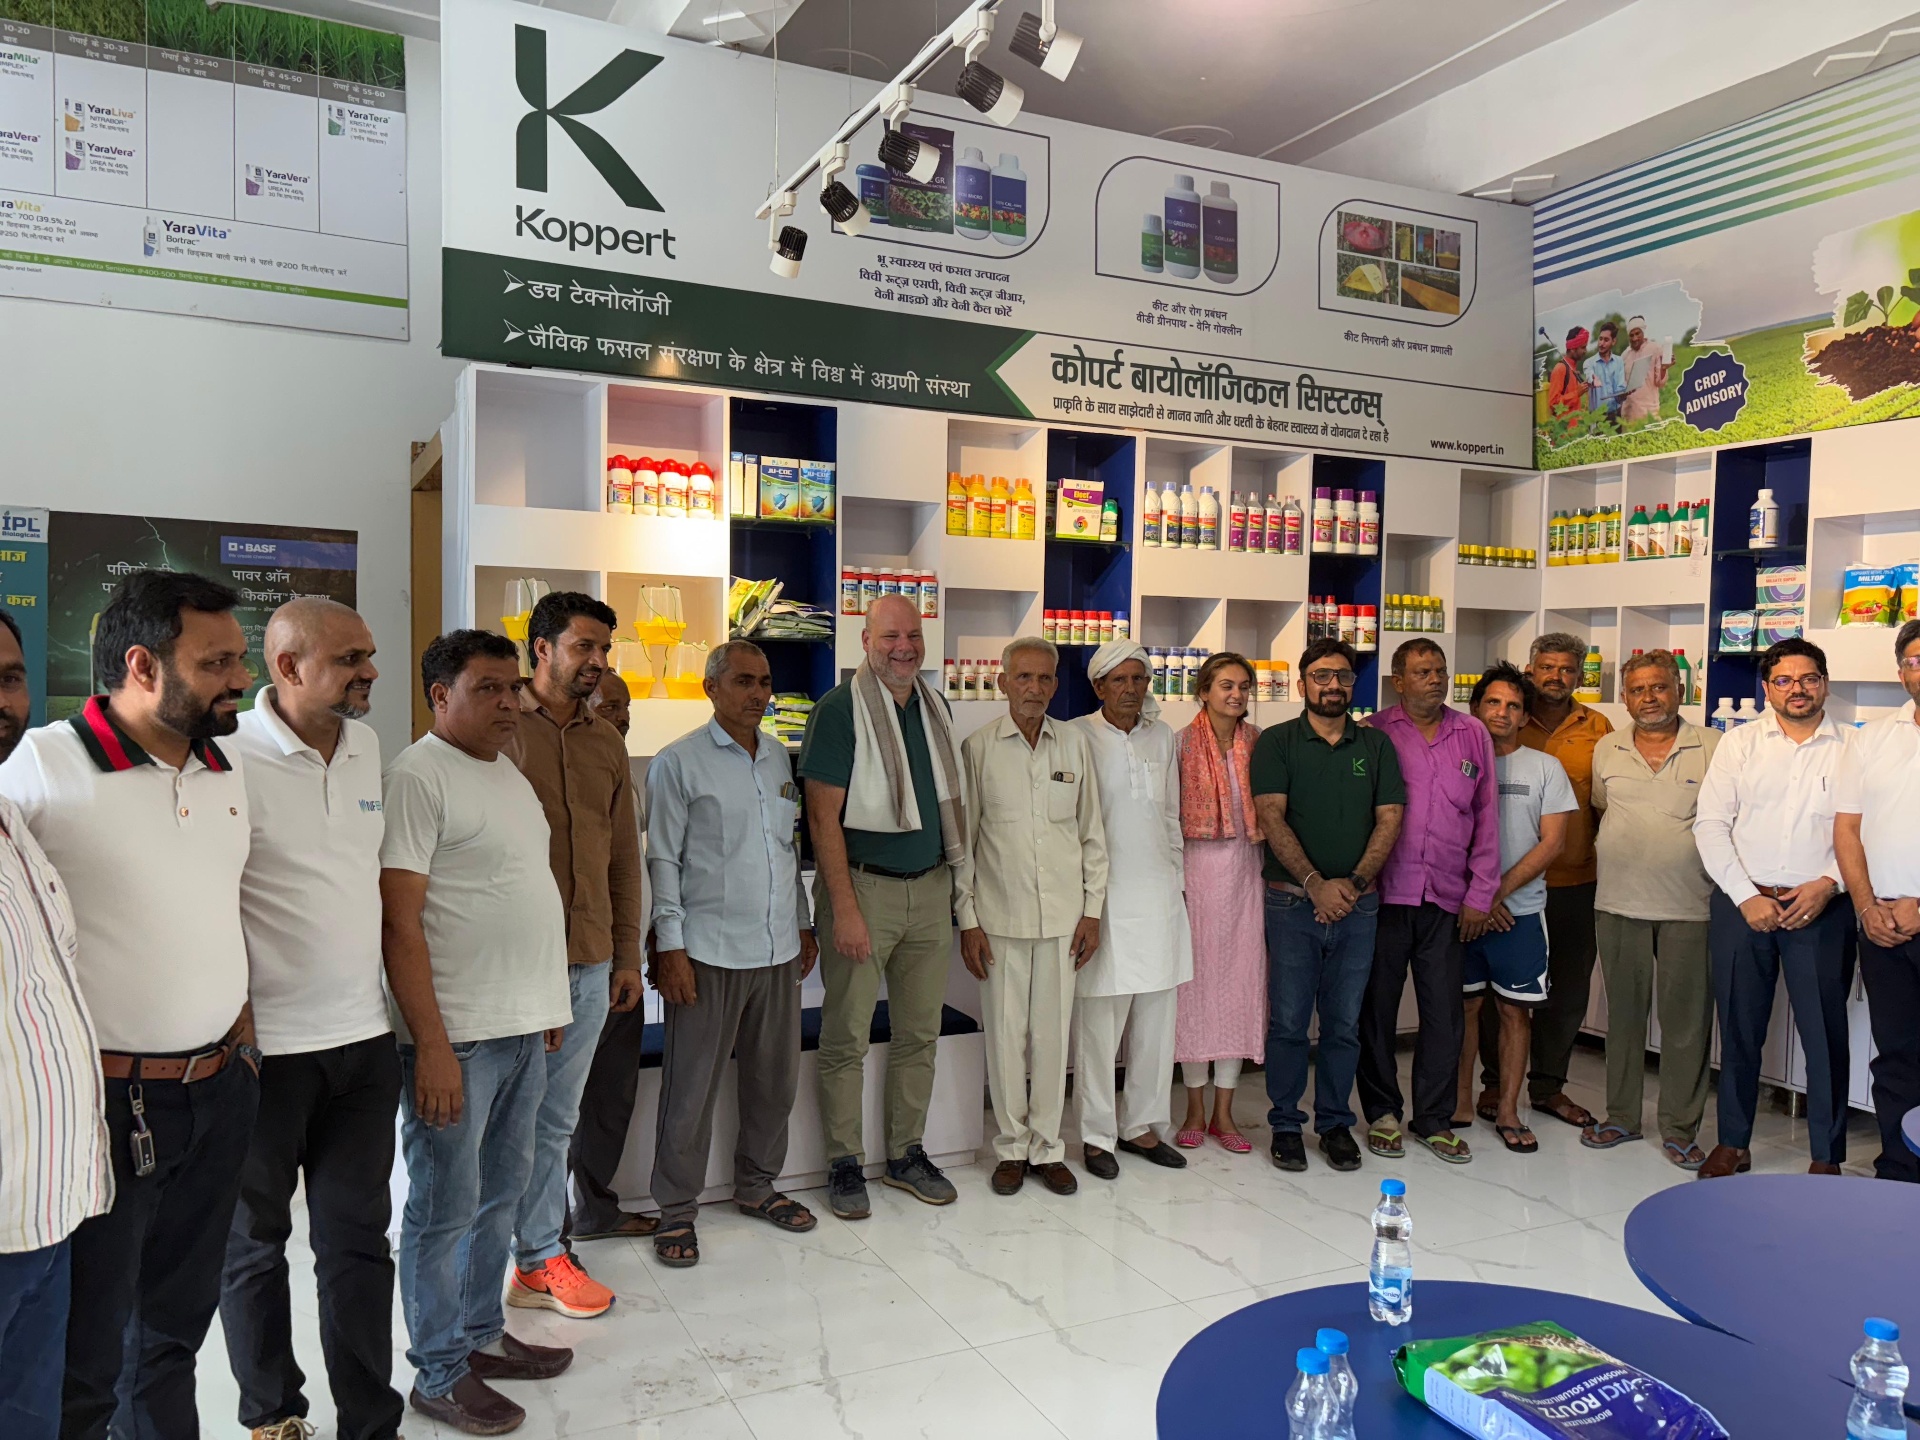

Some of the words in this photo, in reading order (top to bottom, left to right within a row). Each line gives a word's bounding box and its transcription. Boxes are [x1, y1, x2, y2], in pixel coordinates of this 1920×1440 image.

[3, 23, 30, 35] 10-20
[103, 42, 129, 53] 30-35
[0, 52, 38, 64] araMila
[194, 59, 218, 68] 35-40
[278, 73, 302, 83] 45-50
[362, 88, 385, 98] 55-60
[87, 104, 133, 119] YaraLiva
[348, 109, 389, 124] YaraTera
[0, 130, 38, 142] araVera
[87, 142, 133, 157] YaraVera
[115, 162, 129, 170] 46%
[265, 169, 308, 183] YaraVera
[0, 200, 41, 213] raVita
[18, 213, 34, 221] 700
[36, 215, 62, 225] (39.5%
[64, 220, 76, 228] Zn)
[33, 225, 54, 233] 35-40
[162, 219, 228, 240] YaraVita
[516, 204, 676, 260] Koppert
[877, 254, 888, 268] भू
[889, 256, 926, 271] स्वास्थ्य
[929, 261, 943, 274] एवं
[945, 265, 972, 277] फसल
[974, 269, 1011, 283] उत्पादन
[859, 268, 882, 282] विची
[912, 278, 942, 293] एसपी,
[945, 282, 967, 295] विची
[995, 289, 1026, 305] जीआर,
[527, 280, 563, 302] डच
[569, 279, 672, 316] टेक्नोलॉजी
[874, 287, 894, 301] वेनी
[897, 293, 929, 306] माइक्रो
[931, 295, 949, 309] और
[952, 298, 970, 312] वेनी
[973, 300, 992, 314] कैल
[1152, 299, 1169, 312] कीट
[1171, 301, 1187, 315] और
[1189, 304, 1203, 317] रोग
[1136, 311, 1155, 325] वीडी
[1157, 314, 1188, 329] ग्रीनपाथ
[1196, 318, 1211, 333] वेनि
[1213, 322, 1243, 336] गोक्लीन
[1343, 330, 1359, 343] कीट
[1361, 332, 1389, 347] निगरानी
[1391, 336, 1405, 350] और
[1430, 344, 1453, 357] प्रणाली
[527, 324, 590, 353] जैविक
[596, 336, 652, 361] फसल
[658, 341, 722, 370] संरक्षण
[728, 347, 747, 372] के
[753, 351, 785, 377] क्षेत्र
[790, 355, 806, 379] में
[810, 358, 845, 384] विश्व
[850, 362, 865, 386] में
[870, 370, 920, 393] अग्रणी
[925, 374, 971, 399] संस्था
[1051, 344, 1125, 390] कोपर्ट
[1130, 356, 1290, 409] बायोलॉजिकल
[1296, 373, 1386, 427] सिस्टम्स्
[1694, 369, 1727, 393] CROP
[1685, 382, 1743, 415] ADVISORY
[1053, 395, 1082, 414] प्राकृति
[1085, 396, 1095, 412] के
[1098, 401, 1116, 415] साथ
[1118, 401, 1154, 419] साझेदारी
[1156, 404, 1165, 420] से
[1167, 408, 1192, 423] मानव
[1194, 409, 1213, 425] जाति
[1215, 410, 1232, 426] और
[1234, 413, 1254, 429] धरती
[1256, 414, 1265, 430] के
[1267, 415, 1289, 433] बेहतर
[1291, 422, 1319, 436] स्वास्थ्य
[1321, 421, 1329, 437] में
[1330, 422, 1360, 440] योगदान
[1362, 425, 1368, 441] दे
[1369, 430, 1382, 442] रहा
[1383, 428, 1390, 443] है
[1430, 439, 1504, 455] www.koppert.in
[2, 511, 41, 533] IPL
[2, 531, 41, 539] Biologicals
[245, 543, 277, 554] BASF
[231, 570, 262, 582] पावर
[265, 568, 291, 583] ऑन
[6, 594, 37, 607] कल
[1582, 1370, 1629, 1389] PHOSPHATE
[1540, 1393, 1602, 1420] ROUTZ
[1562, 1409, 1613, 1427] BIOFERTILIZER
